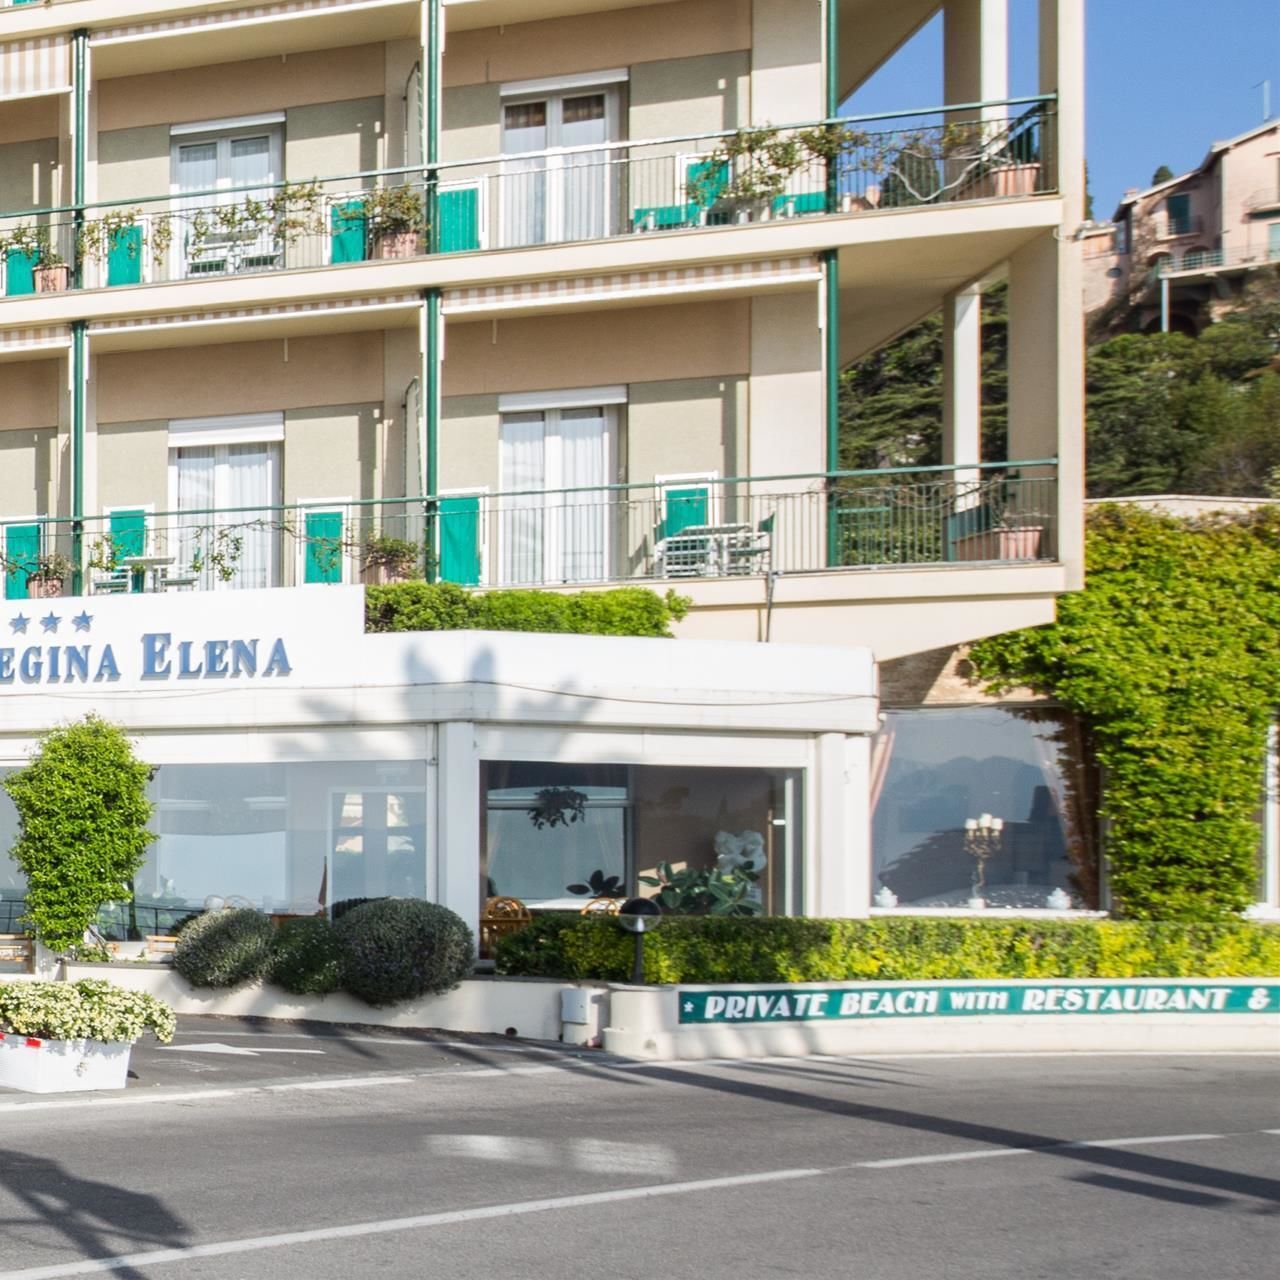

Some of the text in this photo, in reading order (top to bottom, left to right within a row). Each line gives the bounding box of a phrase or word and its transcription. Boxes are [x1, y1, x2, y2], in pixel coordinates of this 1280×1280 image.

[704, 987, 1271, 1019] PRIVATE BEACH WITH RESTAURANT &
